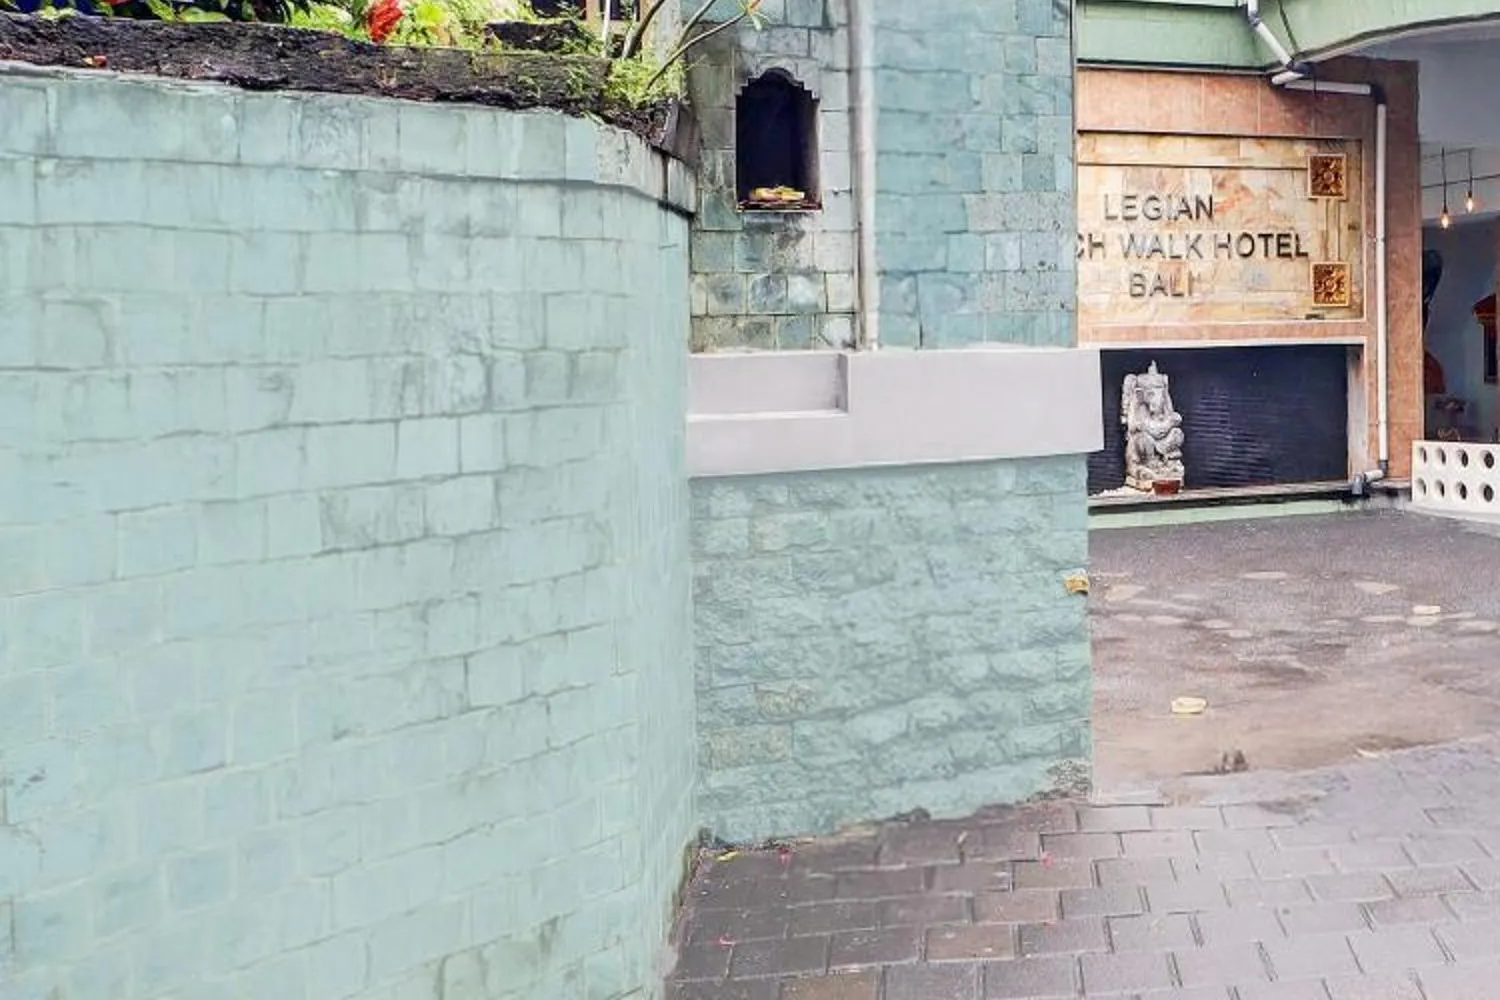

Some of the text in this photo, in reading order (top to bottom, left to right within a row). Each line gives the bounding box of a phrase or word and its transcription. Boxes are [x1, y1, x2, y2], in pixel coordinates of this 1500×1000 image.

[1104, 194, 1214, 221] LEGIAN
[1117, 231, 1204, 260] WALK
[1214, 232, 1309, 258] HOTEL
[1128, 273, 1193, 298] BALI
